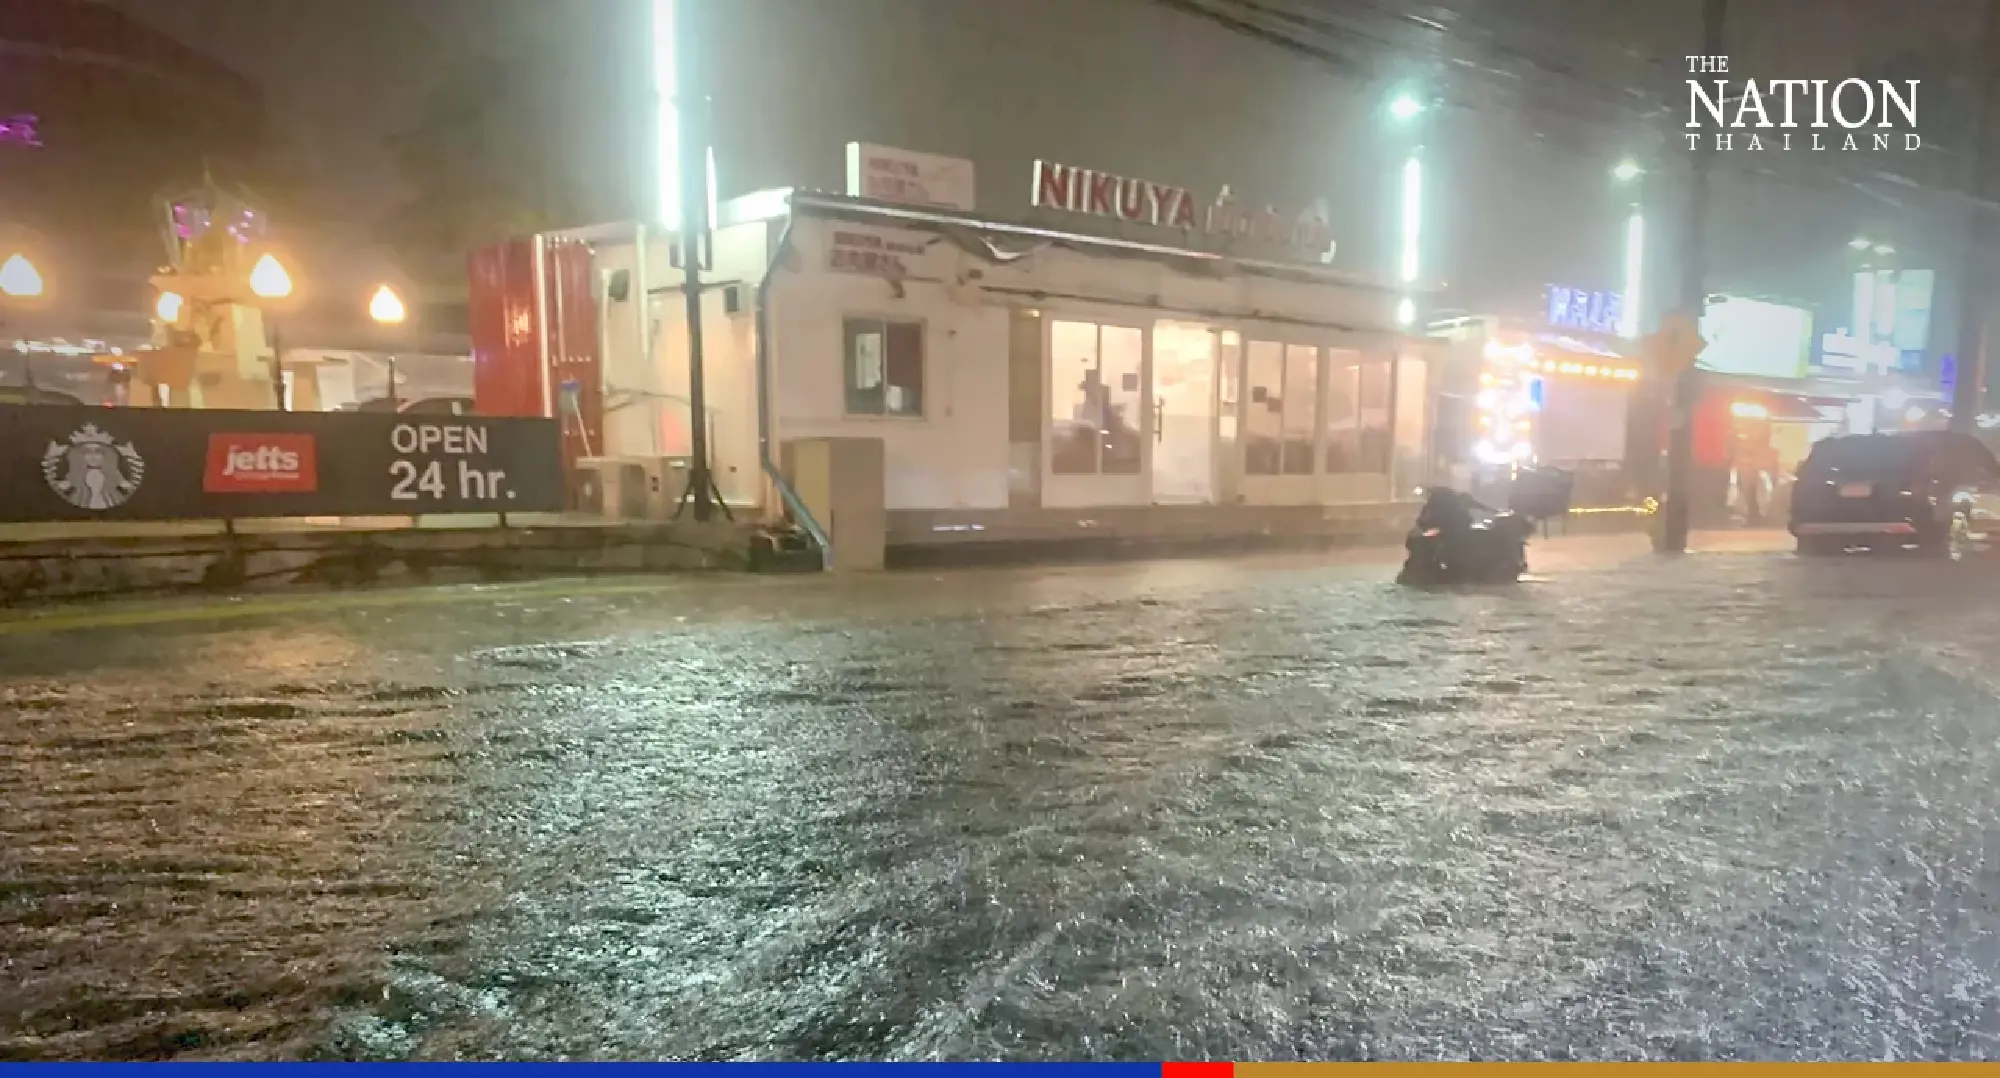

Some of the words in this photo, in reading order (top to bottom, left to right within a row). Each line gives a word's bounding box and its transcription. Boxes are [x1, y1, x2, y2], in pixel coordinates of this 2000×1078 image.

[1031, 159, 1196, 231] NIKUYA
[391, 423, 488, 454] OPEN
[222, 444, 300, 476] jetts
[389, 460, 446, 499] 24
[458, 460, 517, 499] hr.
